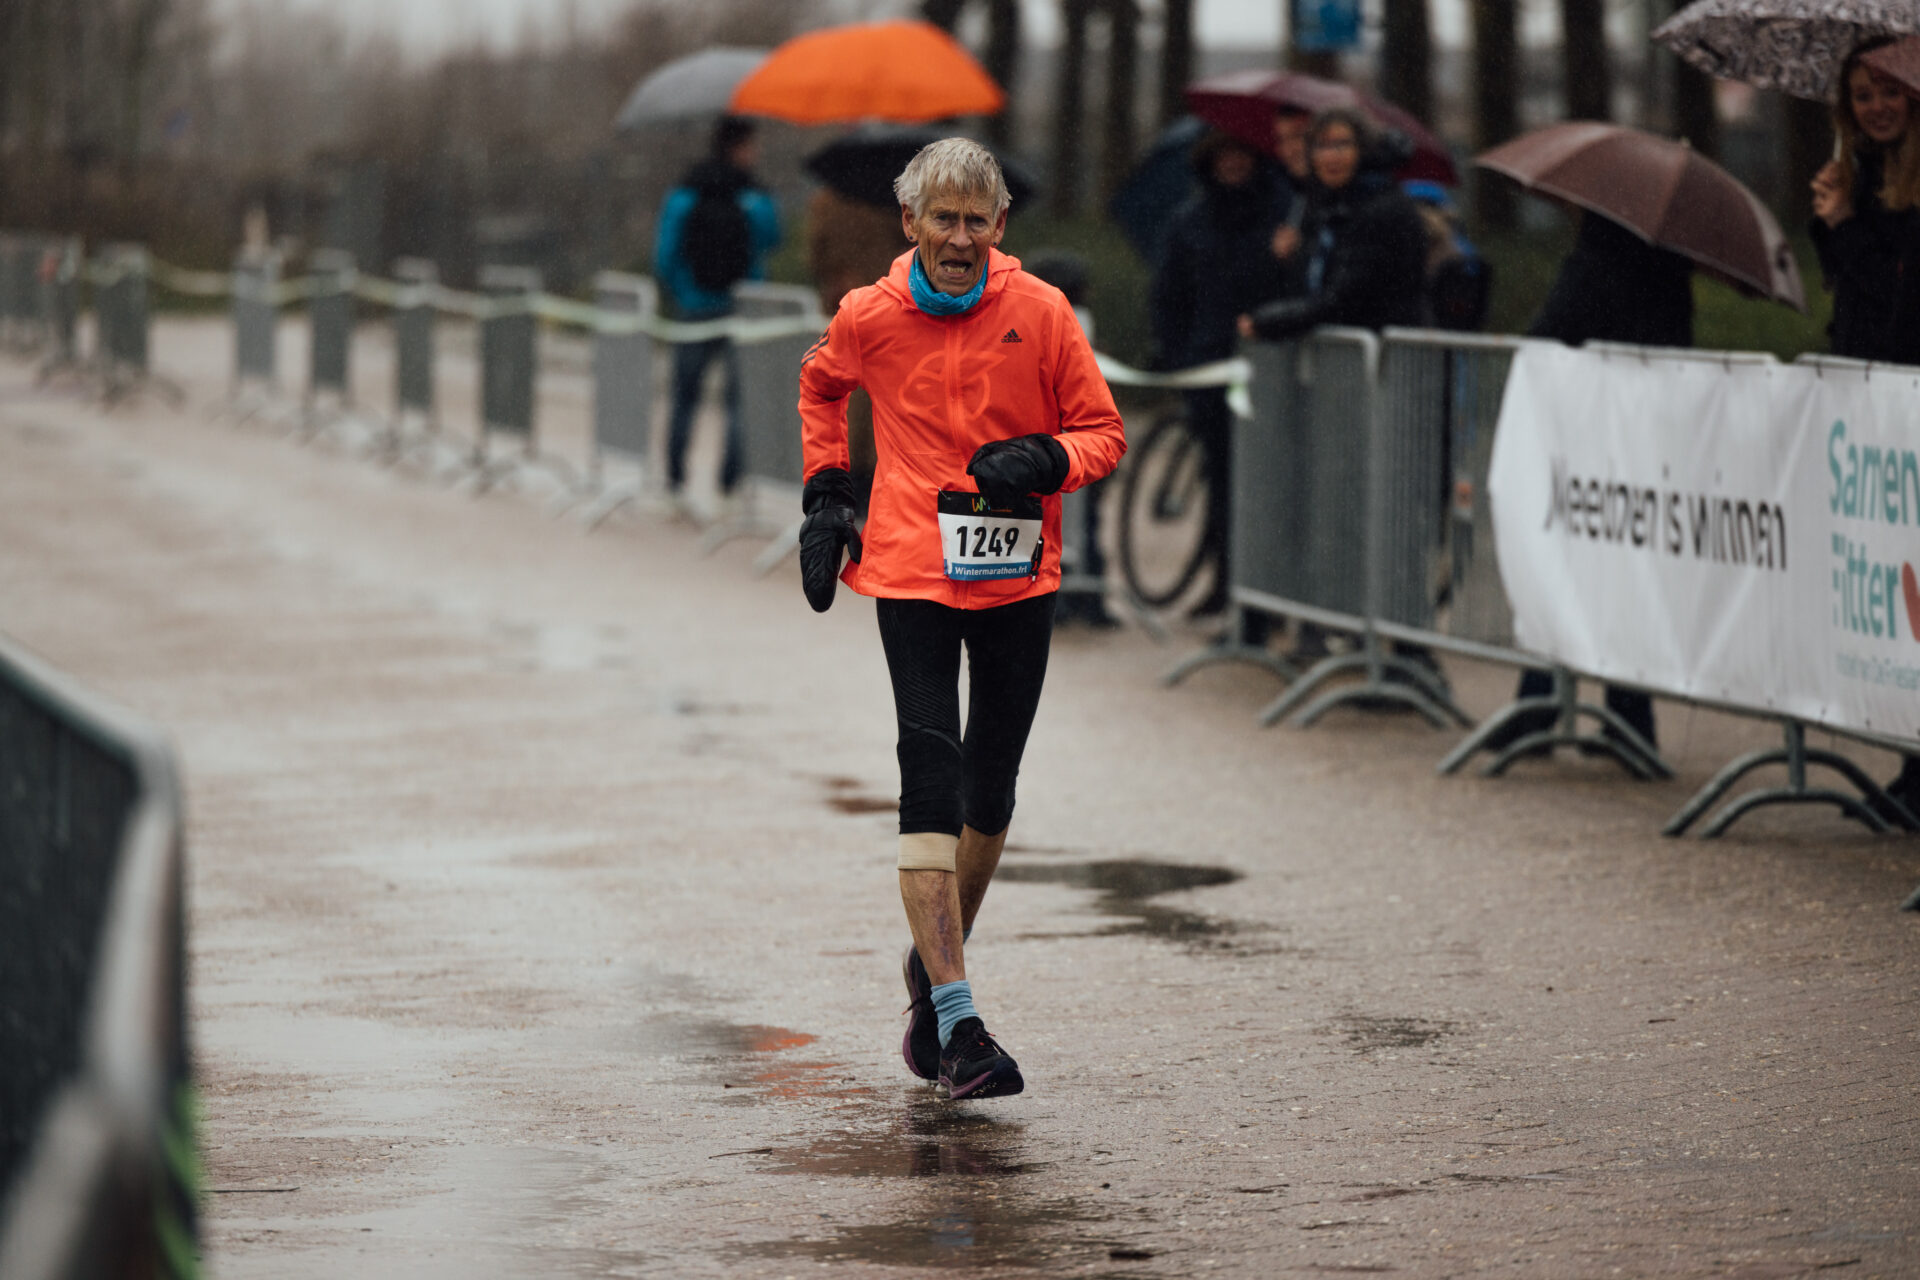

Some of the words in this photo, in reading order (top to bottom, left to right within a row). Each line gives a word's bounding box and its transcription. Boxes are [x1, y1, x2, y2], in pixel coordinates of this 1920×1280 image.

[1663, 462, 1682, 556] is
[1688, 469, 1786, 571] winnen
[1828, 417, 1920, 527] Samen
[956, 526, 1020, 557] 1249
